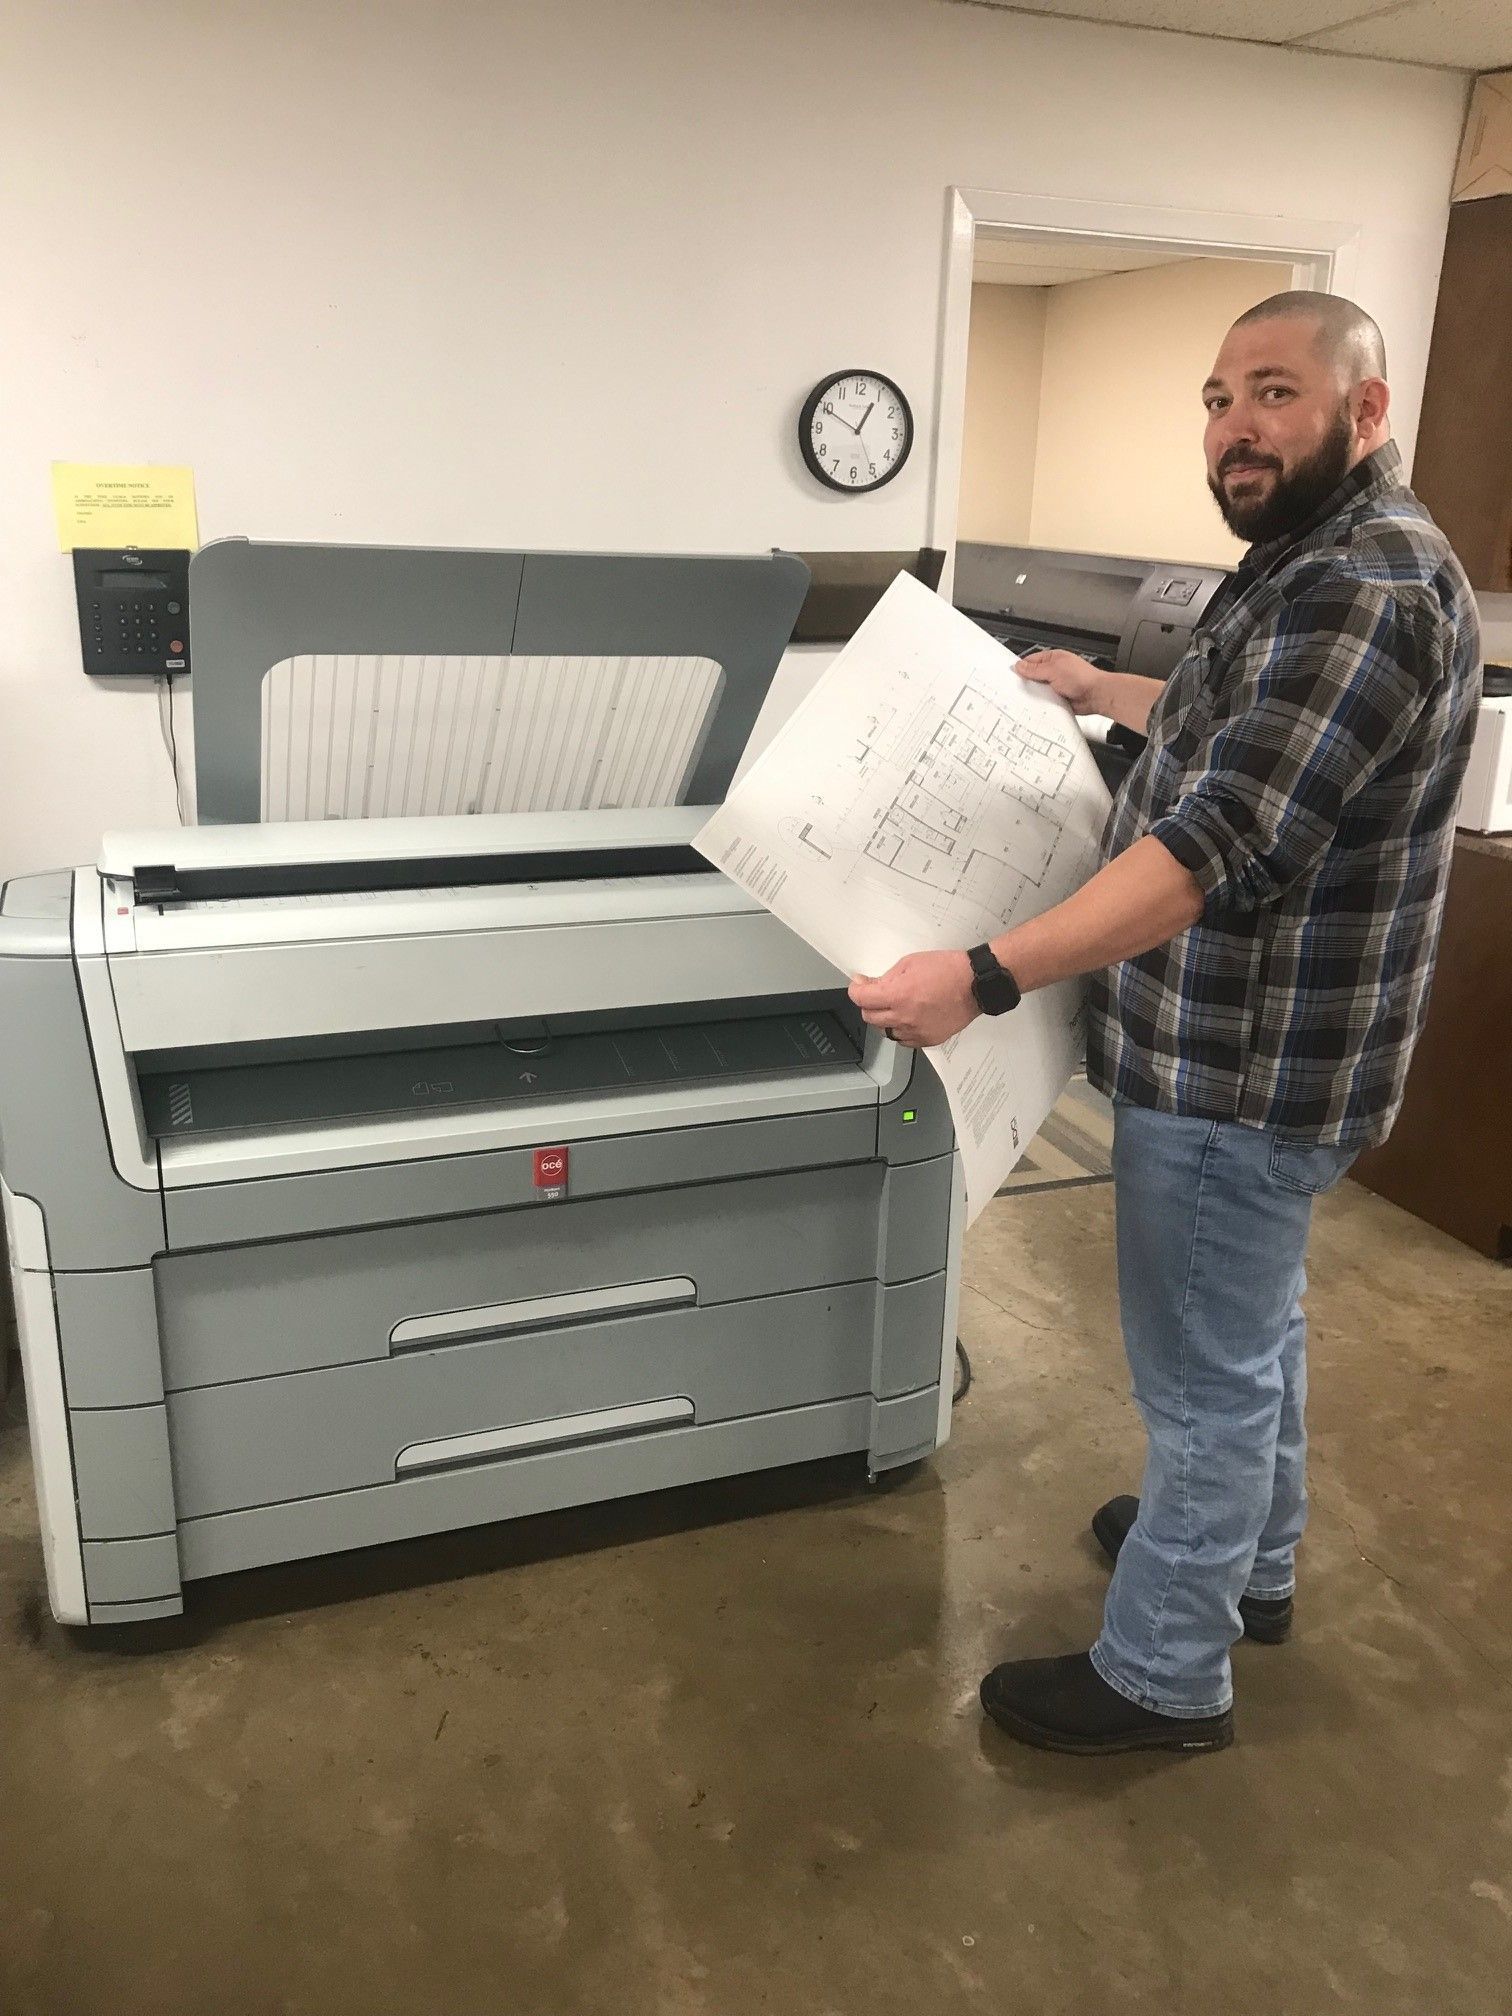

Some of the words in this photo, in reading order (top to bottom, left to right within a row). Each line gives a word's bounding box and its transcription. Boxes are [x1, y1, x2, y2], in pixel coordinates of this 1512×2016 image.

[839, 387, 846, 400] 11
[855, 382, 867, 396] 12
[823, 402, 833, 414] 10
[887, 406, 895, 419] 2
[815, 421, 823, 434] 9
[891, 427, 899, 440] 3
[819, 443, 827, 456] 8
[883, 449, 891, 461] 4
[832, 459, 840, 472] 7
[868, 462, 876, 475] 5
[849, 466, 857, 479] 6
